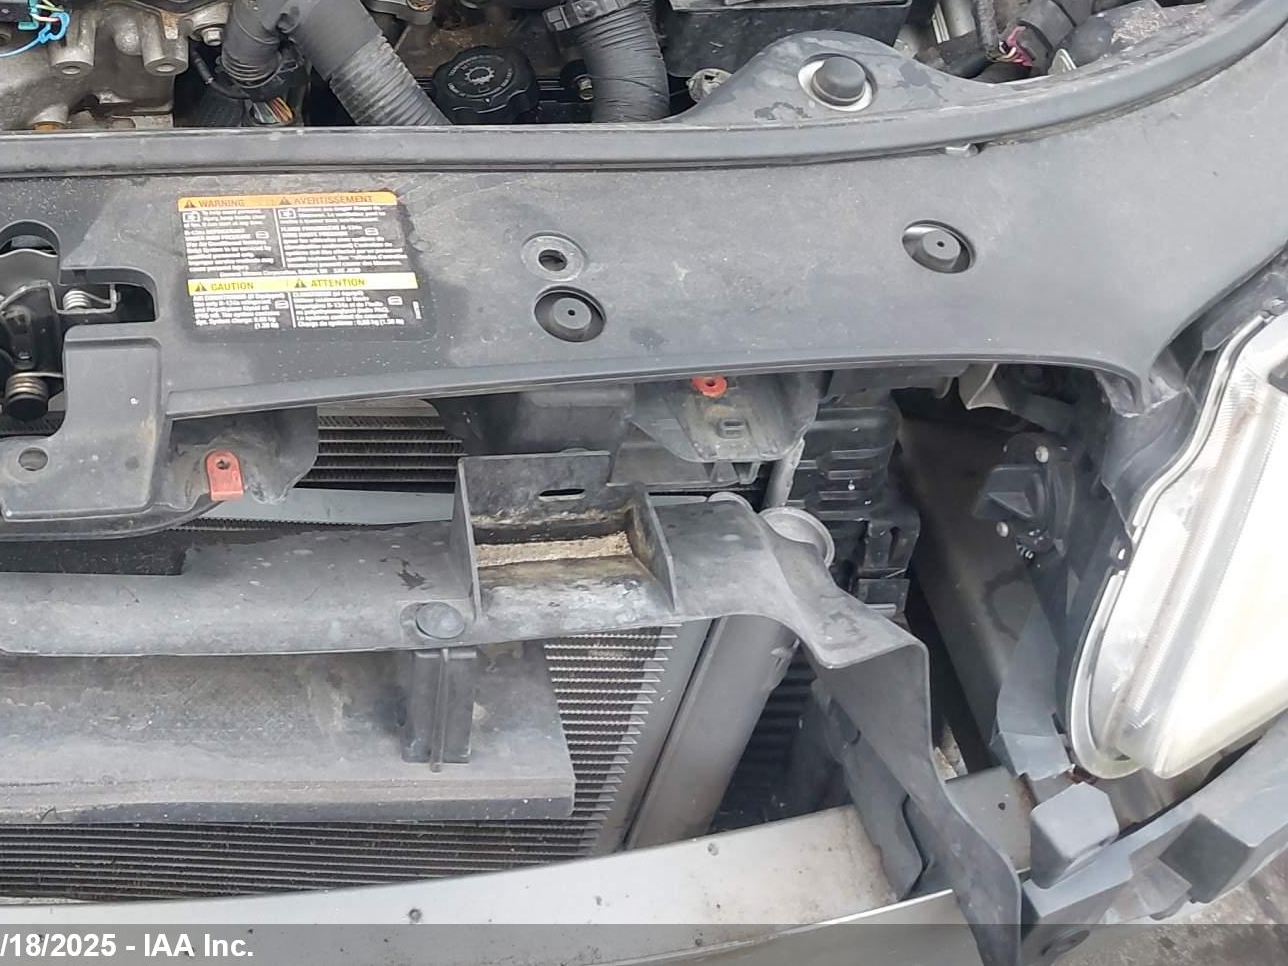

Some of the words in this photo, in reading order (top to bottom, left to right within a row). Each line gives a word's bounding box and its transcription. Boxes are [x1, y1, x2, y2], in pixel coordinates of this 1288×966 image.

[198, 199, 245, 208] WARNING
[294, 195, 374, 205] AVERTISSEMENT
[211, 281, 254, 291] CAUTION
[311, 278, 366, 288] ATTENTION
